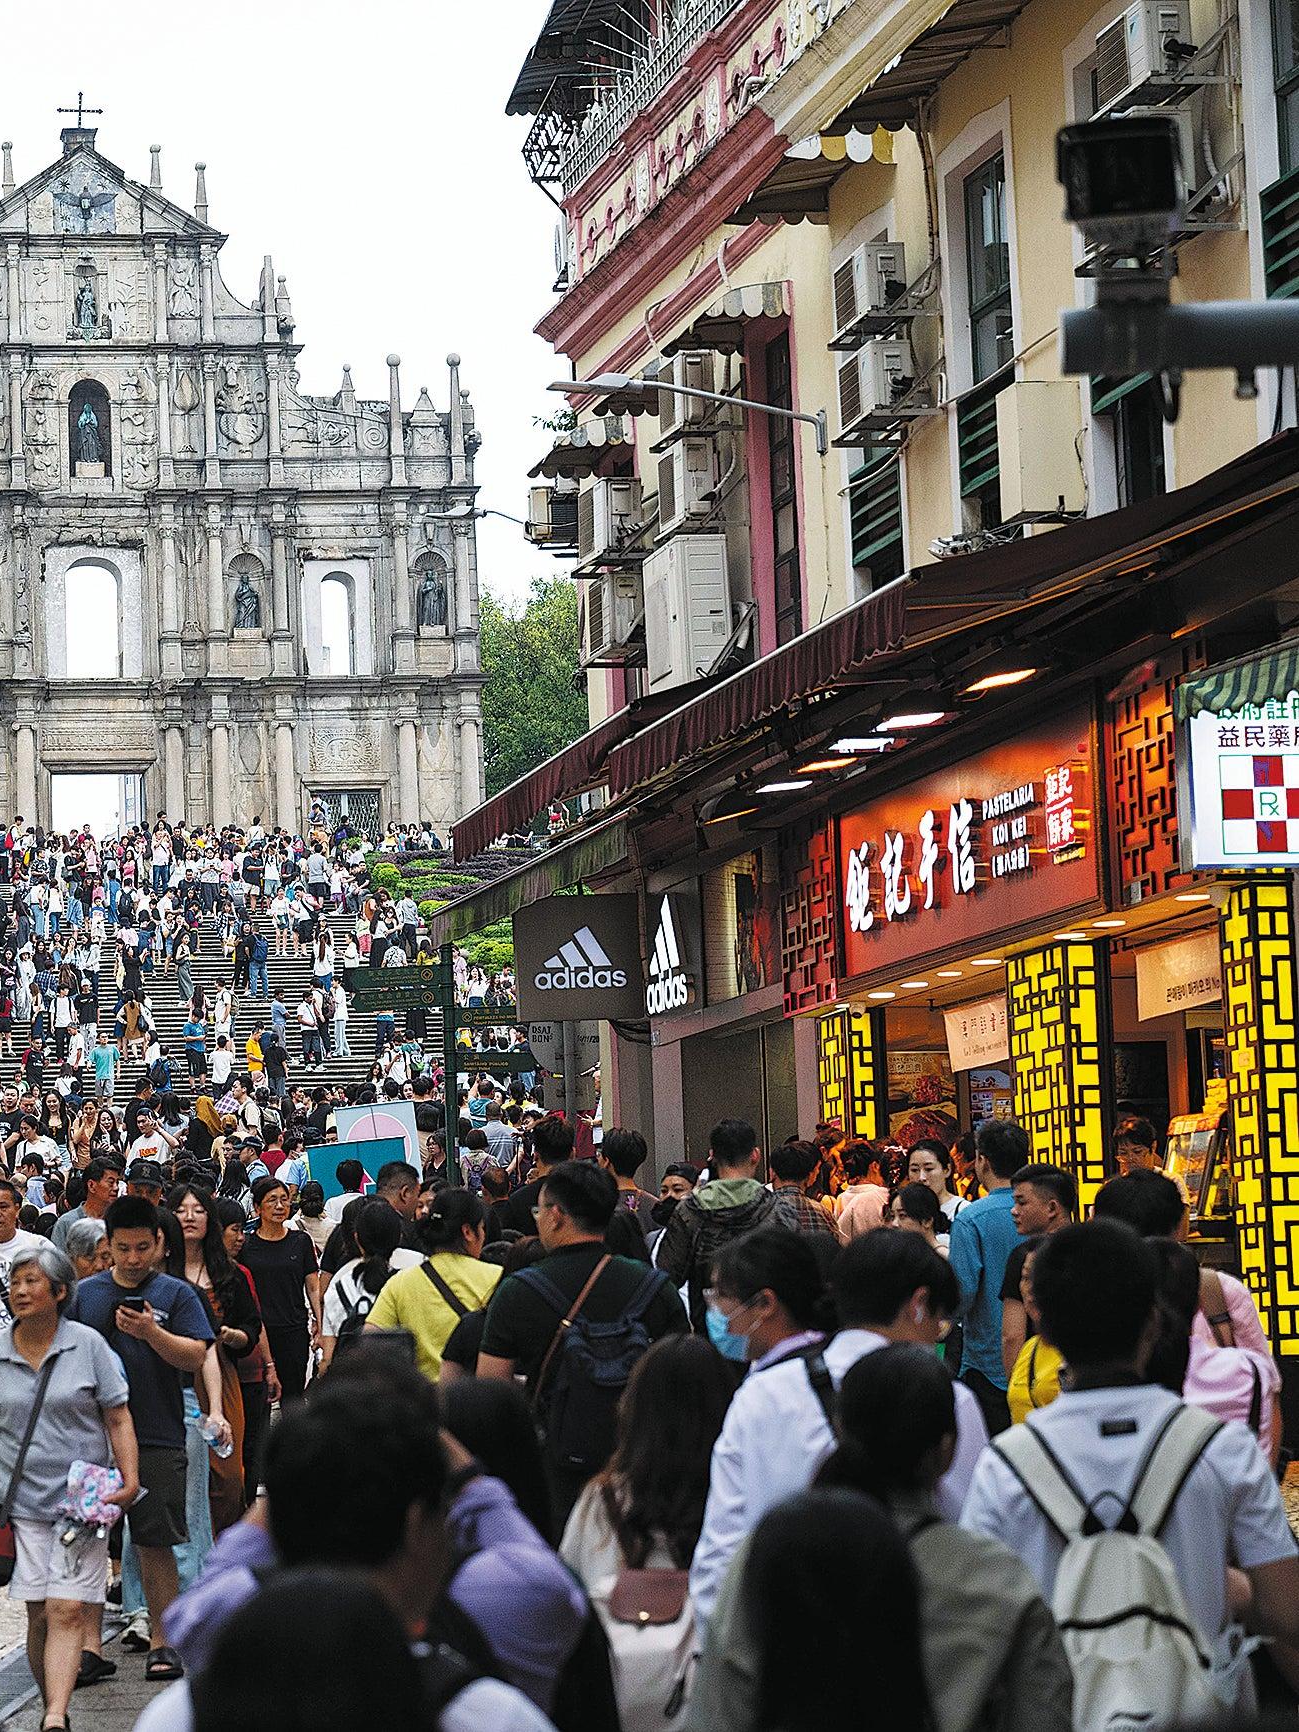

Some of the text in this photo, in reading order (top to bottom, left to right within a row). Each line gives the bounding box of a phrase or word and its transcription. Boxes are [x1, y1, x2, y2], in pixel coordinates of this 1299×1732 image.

[1218, 725, 1299, 748] 益民藥
[992, 815, 1027, 847] KOI KEI
[534, 966, 628, 990] adidas
[646, 967, 688, 1015] adidas
